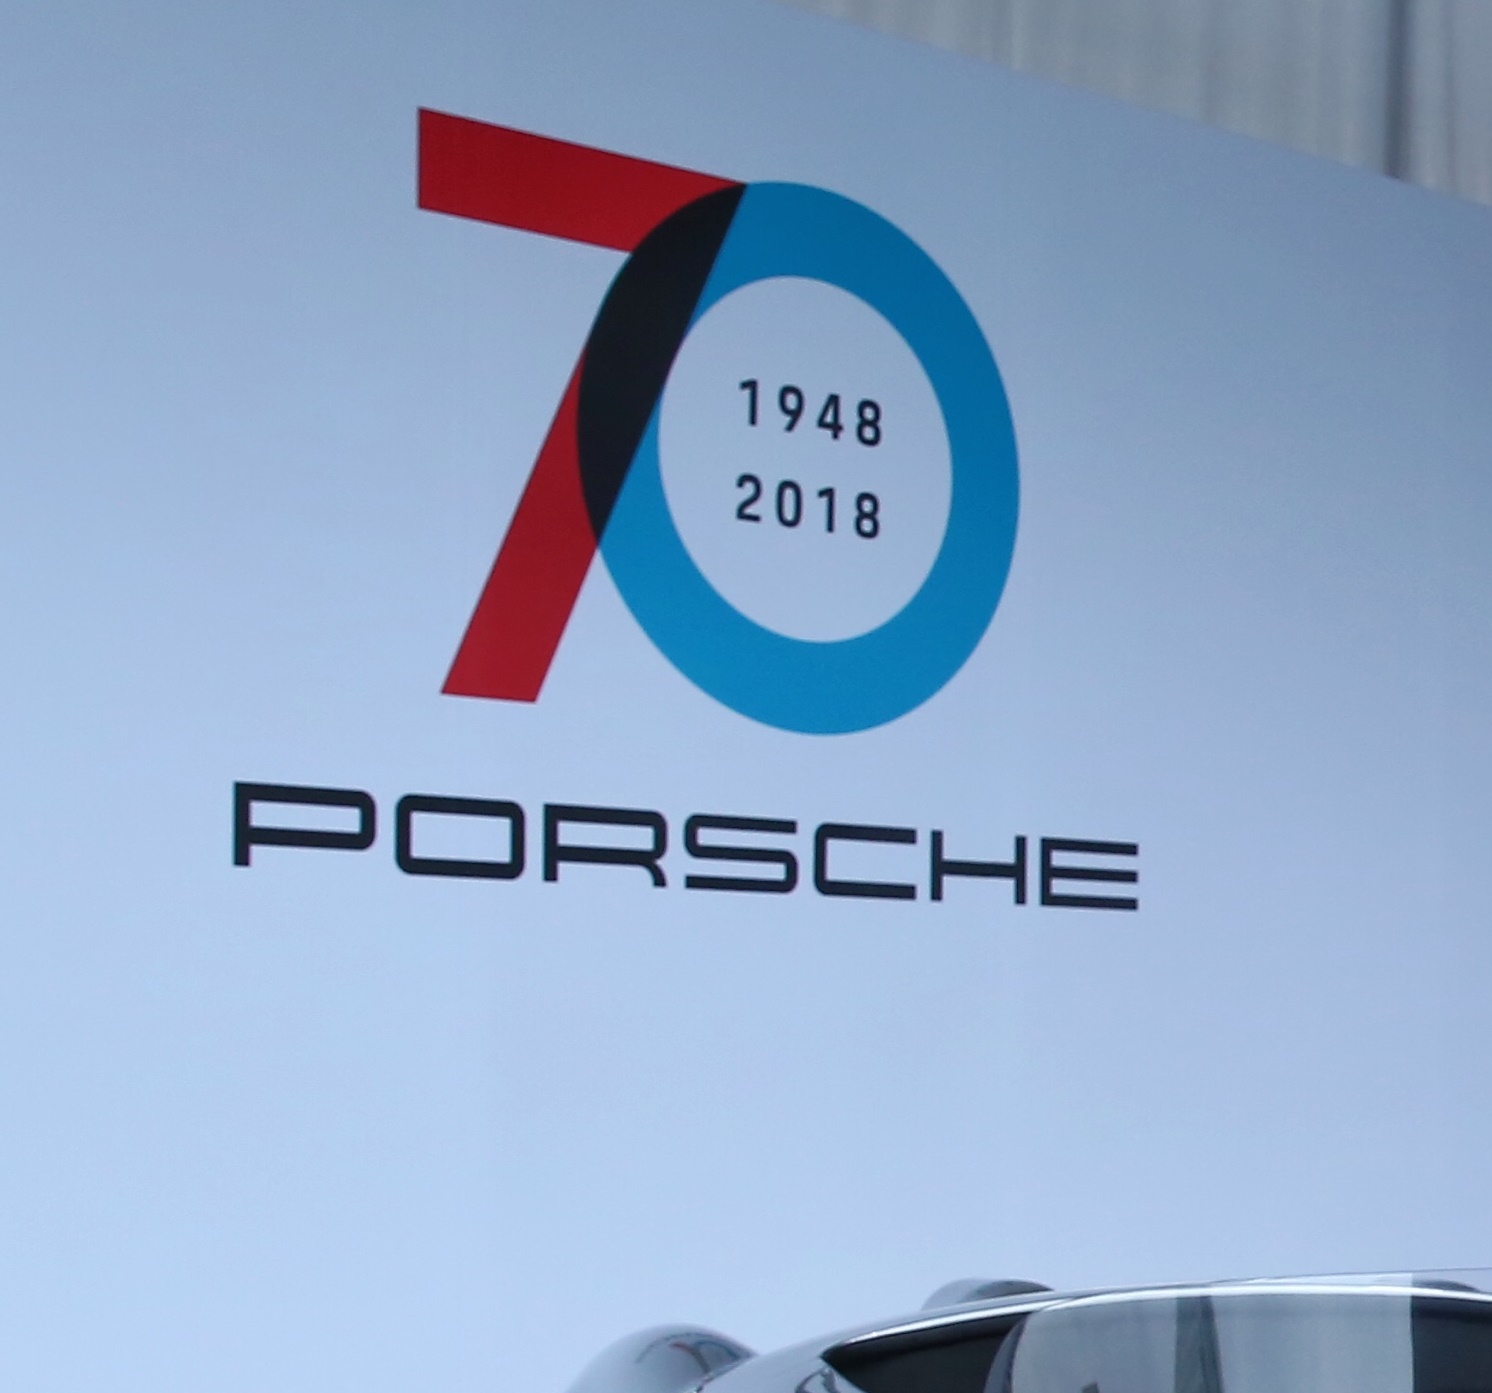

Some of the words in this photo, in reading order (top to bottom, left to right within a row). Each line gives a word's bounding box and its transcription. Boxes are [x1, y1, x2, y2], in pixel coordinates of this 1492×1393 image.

[417, 106, 1021, 737] 70
[736, 378, 884, 448] 1948
[734, 474, 881, 540] 2018
[232, 780, 1140, 912] PORSCHE
